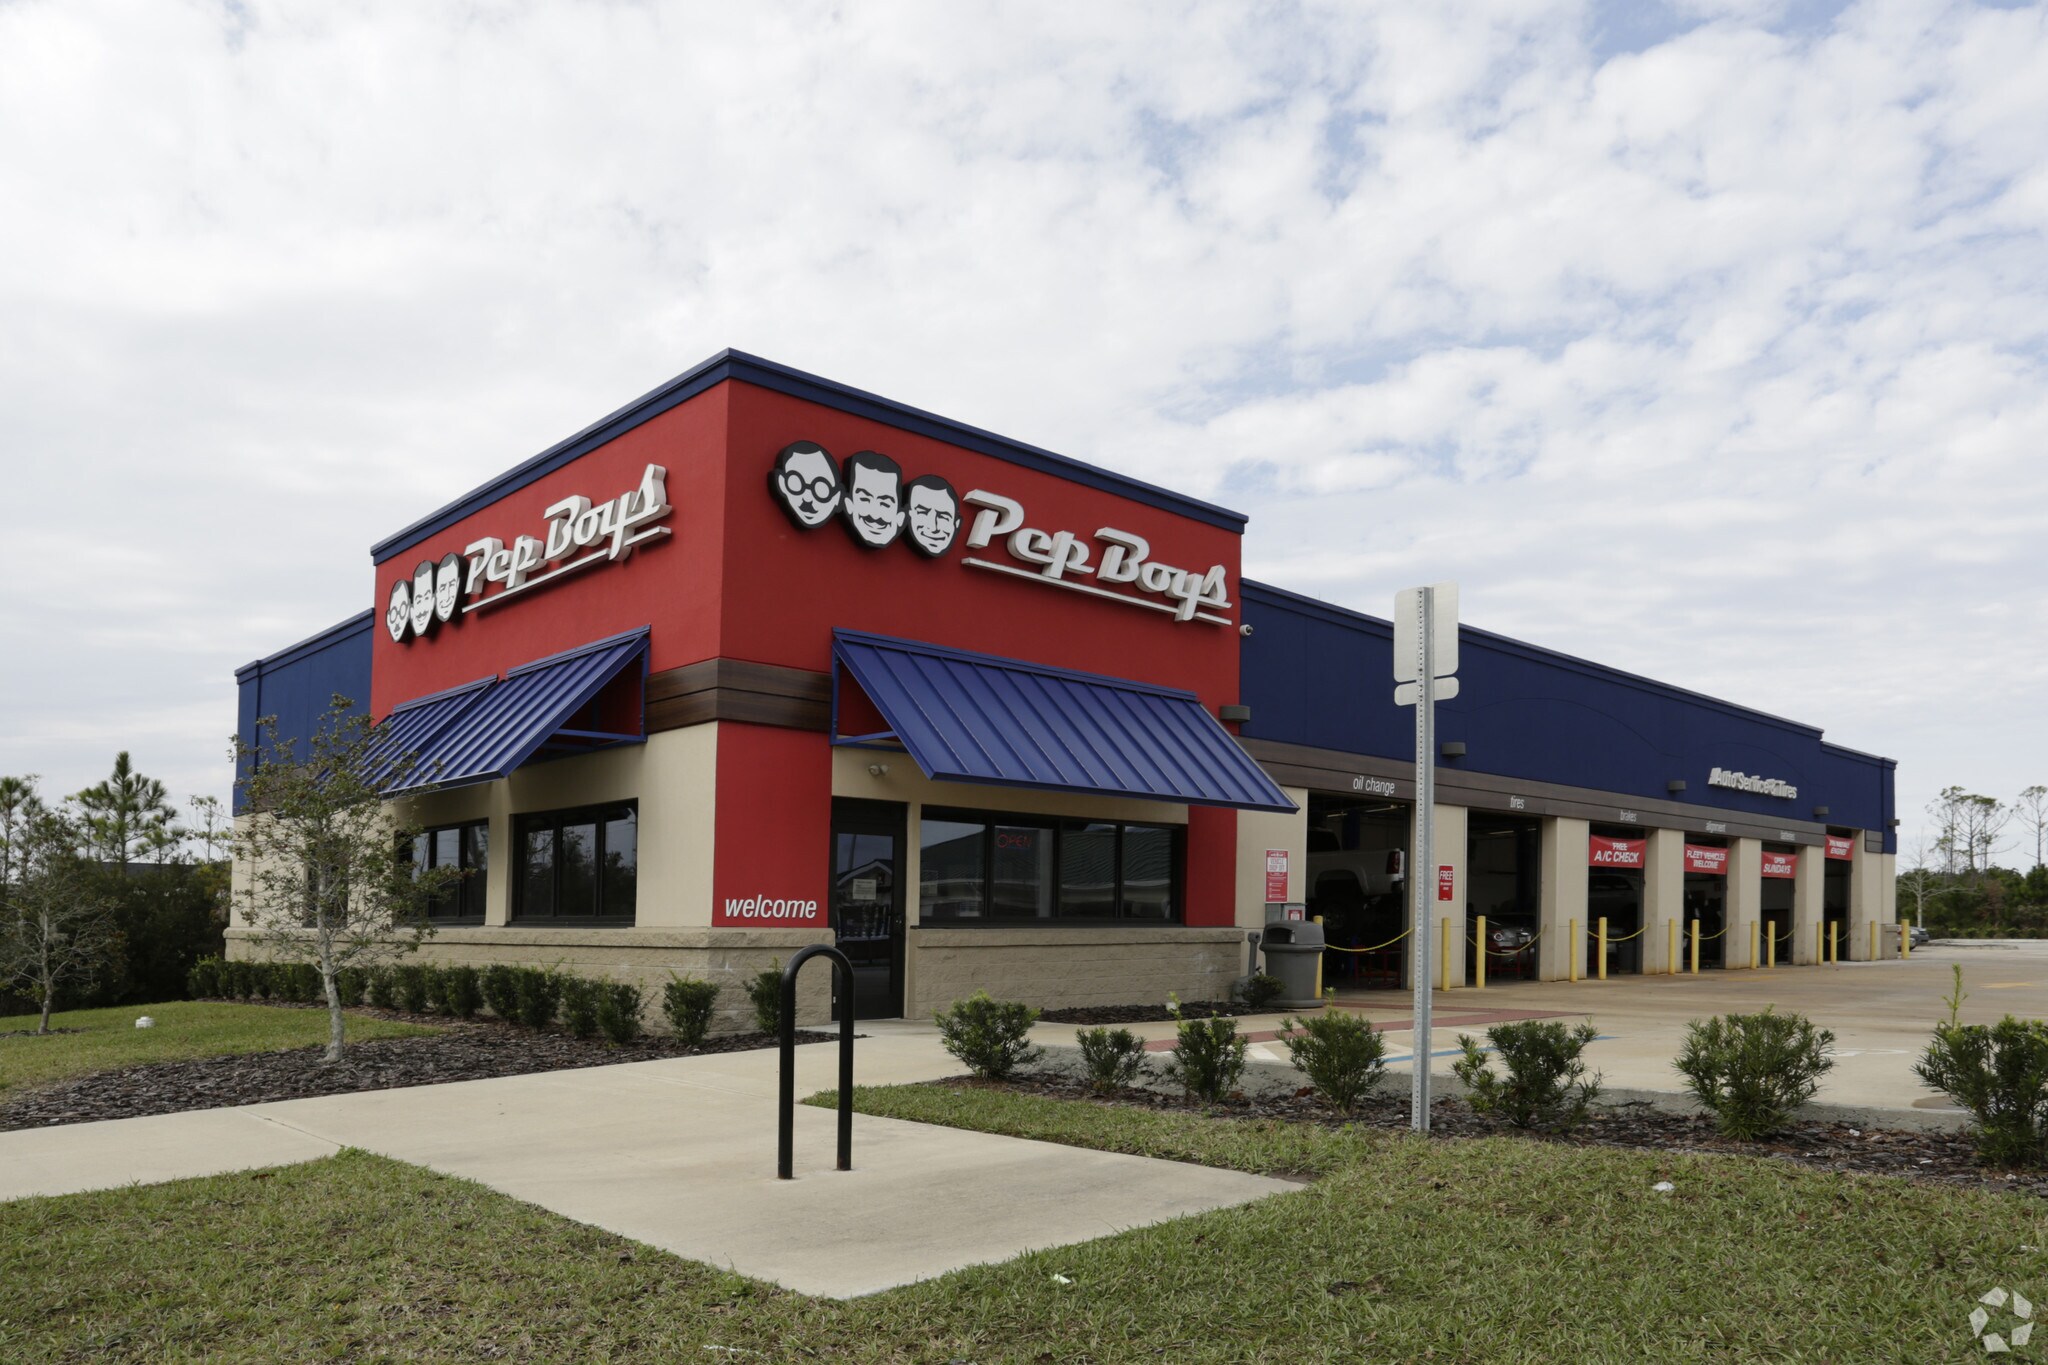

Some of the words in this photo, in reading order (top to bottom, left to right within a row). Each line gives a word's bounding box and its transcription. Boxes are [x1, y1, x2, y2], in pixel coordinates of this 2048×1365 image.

[463, 536, 547, 595] Pep
[543, 463, 672, 562] Boys
[962, 488, 1096, 580] Pep
[1092, 526, 1233, 622] Boys
[1352, 775, 1365, 790] oil
[1365, 776, 1396, 797] change
[1707, 767, 1737, 787] Auto
[1735, 772, 1771, 793] Service
[1776, 780, 1797, 799] Tires
[1509, 795, 1525, 810] tires
[996, 833, 1032, 849] OPEN
[1611, 842, 1628, 851] FREE
[1593, 850, 1612, 862] A/C
[1613, 851, 1640, 863] CHECK
[1686, 850, 1704, 859] FLEET
[1693, 859, 1719, 869] WELCOME
[1763, 863, 1792, 874] SUNDAYS
[1440, 870, 1453, 881] FREE
[724, 893, 817, 919] welcome
